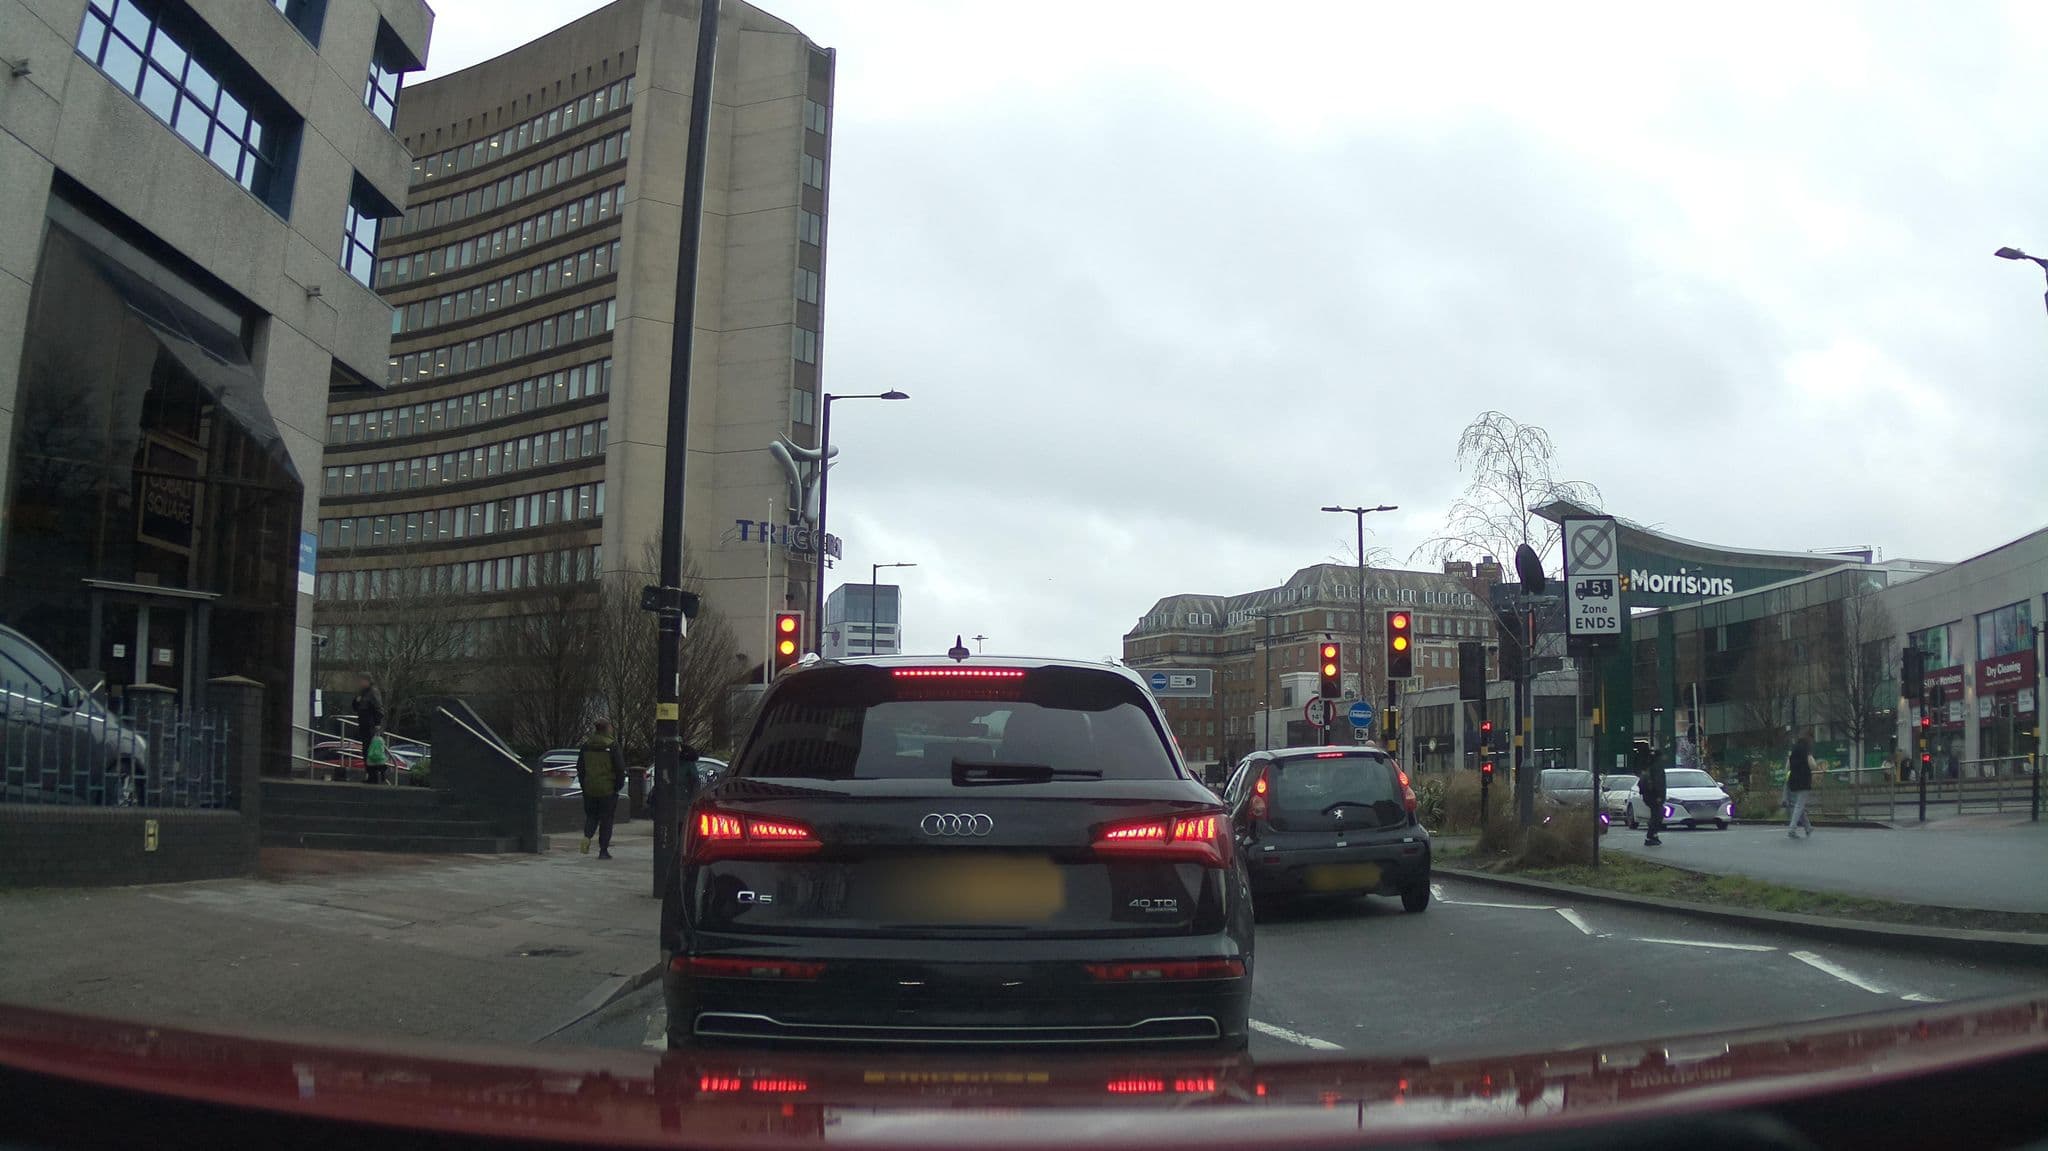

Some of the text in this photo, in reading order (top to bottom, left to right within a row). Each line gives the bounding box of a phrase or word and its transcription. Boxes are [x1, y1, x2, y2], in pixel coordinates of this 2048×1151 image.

[1630, 568, 1734, 595] Morrisons
[1582, 604, 1608, 614] Zone
[1575, 617, 1616, 629] ENDS
[1986, 661, 2021, 678] Dry Cleaning
[737, 891, 773, 904] Q5
[1129, 899, 1177, 907] 40 TDI
